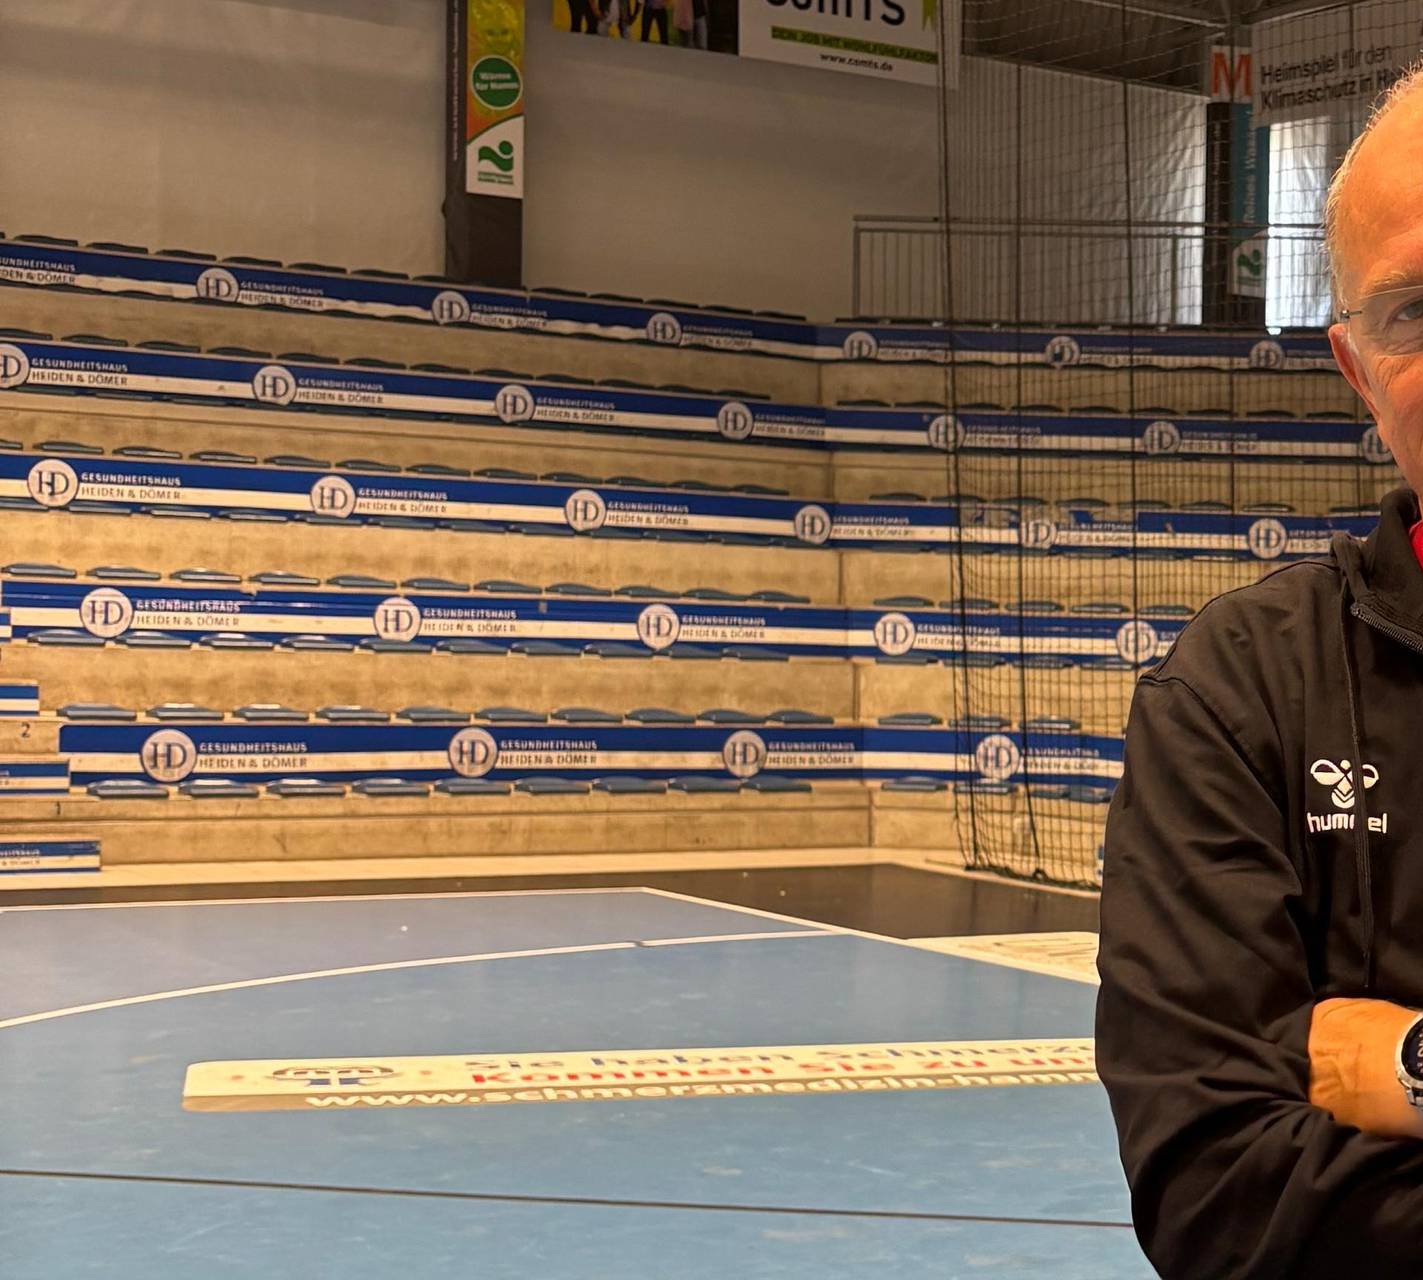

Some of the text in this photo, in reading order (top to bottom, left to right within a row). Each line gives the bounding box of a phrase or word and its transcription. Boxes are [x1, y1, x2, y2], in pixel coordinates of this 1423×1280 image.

[1260, 54, 1338, 85] Heimspiel
[1363, 43, 1392, 65] den
[31, 357, 129, 373] GESUNDHEITSHAUS
[31, 371, 74, 383] HEIDEN
[261, 374, 289, 393] HD
[298, 377, 385, 392] GESUNDHEITSHAUS
[298, 390, 335, 402] HEIDEN
[35, 470, 70, 496] HD
[81, 471, 182, 487] GESUNDHEITSHAUS
[81, 486, 181, 500] HEIDEN & DÖMER
[318, 488, 348, 510] HD
[571, 499, 599, 522] HD
[89, 600, 124, 625] HD
[136, 600, 241, 613] GESUNDHEITSHAUS
[423, 607, 518, 620] GESUNDHEITSHAUS
[136, 614, 240, 627] HEIDEN & DÖMER
[383, 608, 413, 633] HD
[423, 621, 465, 632] HEIDEN
[645, 612, 673, 637] HD
[882, 620, 908, 645] HD
[21, 723, 31, 738] 2
[199, 743, 308, 754] GESUNDHEITSHAUS
[457, 741, 489, 766] HD
[501, 740, 598, 751] GESUNDHEITSHAUS
[150, 742, 187, 769] HD
[199, 756, 308, 769] HEIDEN & DÖMER
[501, 754, 542, 765] HEIDEN
[730, 742, 760, 768] HD
[1306, 811, 1388, 834] humel
[471, 1066, 771, 1084] Kommen
[1007, 1056, 1094, 1066] un
